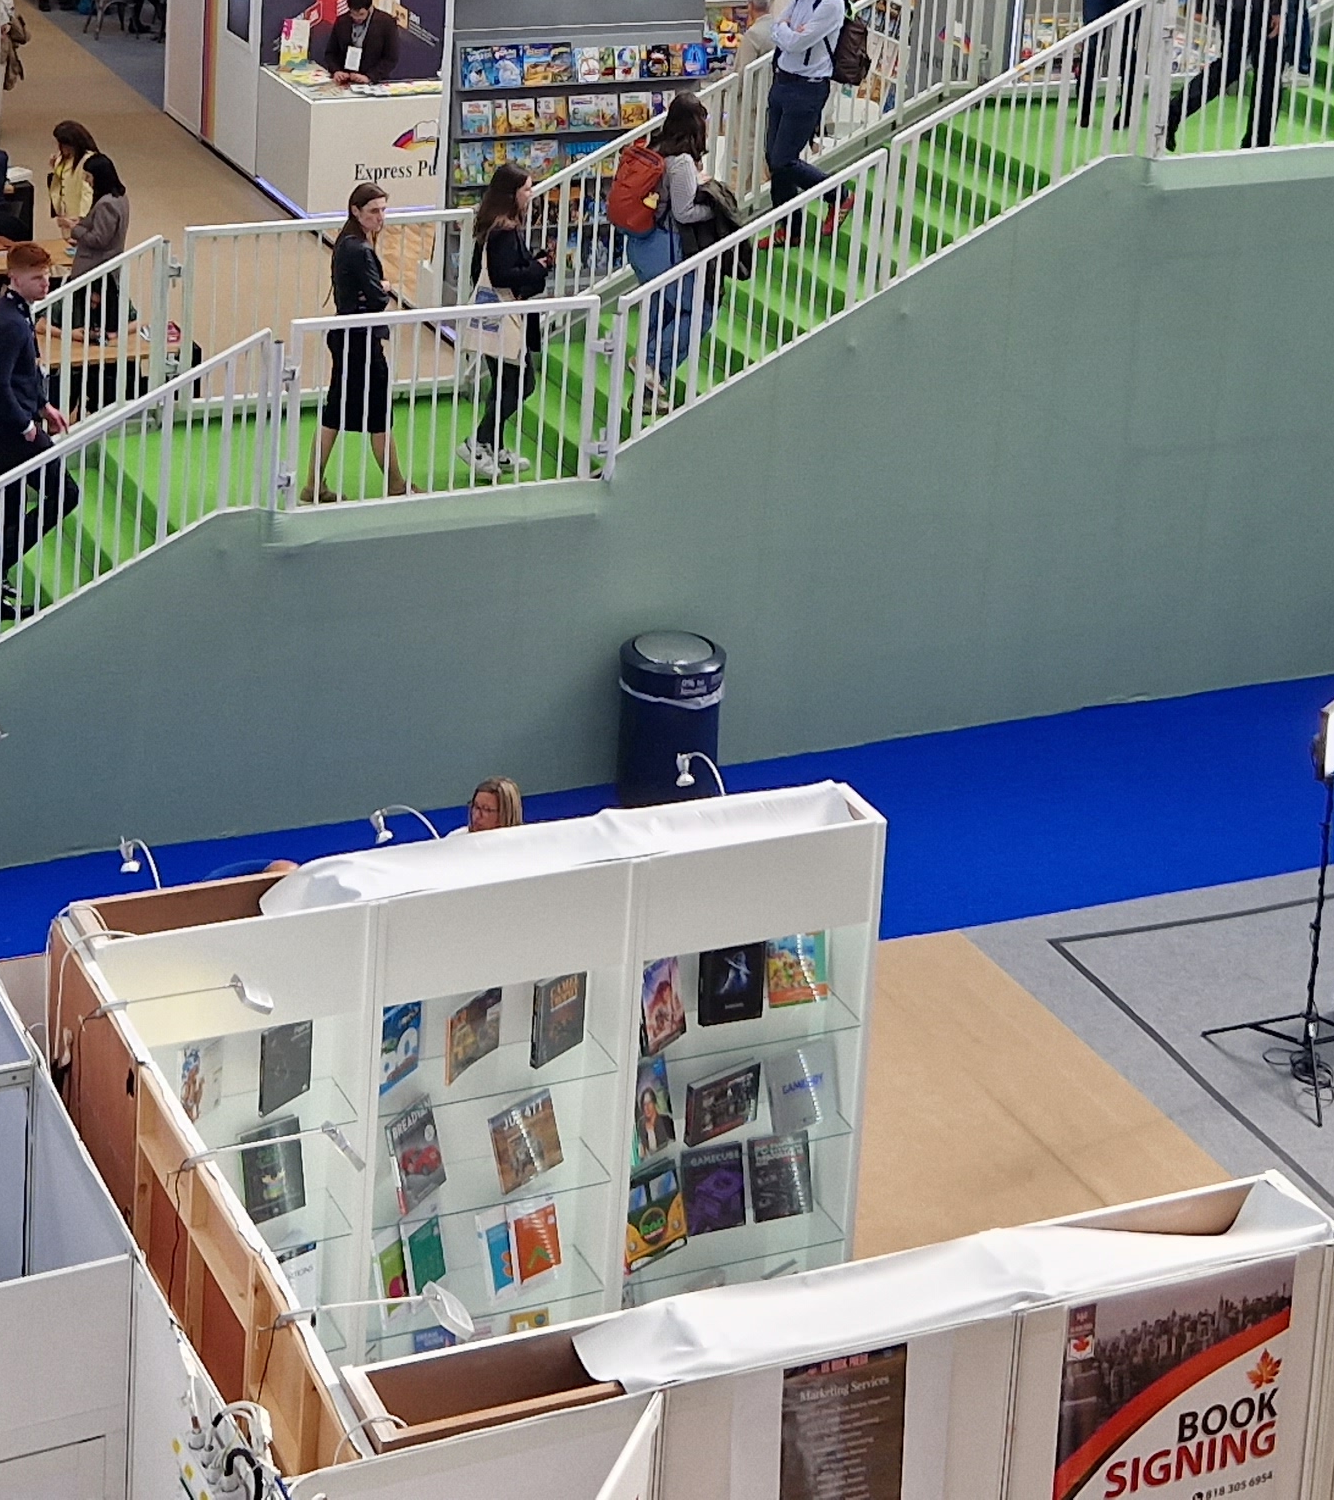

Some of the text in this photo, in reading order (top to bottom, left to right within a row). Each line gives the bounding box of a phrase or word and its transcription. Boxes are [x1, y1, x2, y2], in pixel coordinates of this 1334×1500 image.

[354, 162, 412, 185] Express
[799, 1375, 890, 1402] Marketing Services
[1177, 1387, 1279, 1443] BOOK
[1104, 1420, 1277, 1500] SIGNING
[1228, 1479, 1247, 1494] 305
[1248, 1470, 1274, 1490] 6954
